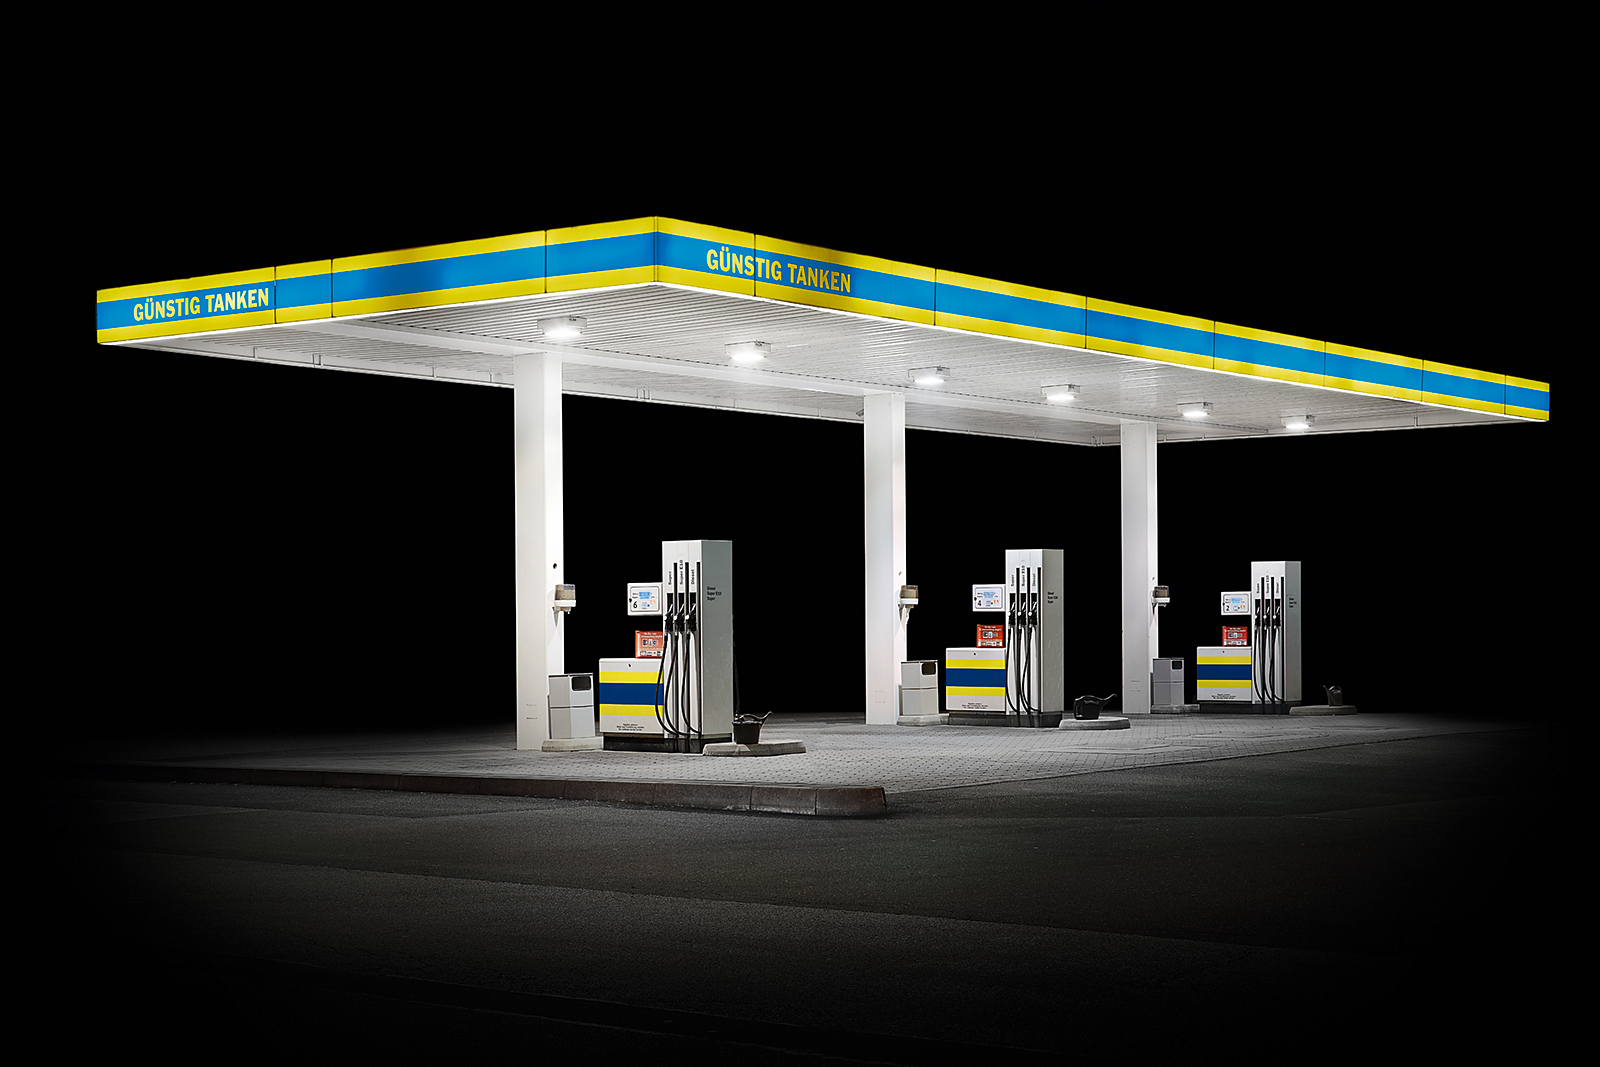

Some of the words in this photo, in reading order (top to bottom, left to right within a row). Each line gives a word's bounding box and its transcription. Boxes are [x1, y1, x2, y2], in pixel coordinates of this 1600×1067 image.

[706, 246, 782, 281] GÜNSTIG
[787, 263, 851, 293] TANKEN
[133, 298, 200, 321] GÜNSTIG
[205, 287, 269, 313] TANKEN
[633, 601, 638, 609] 6
